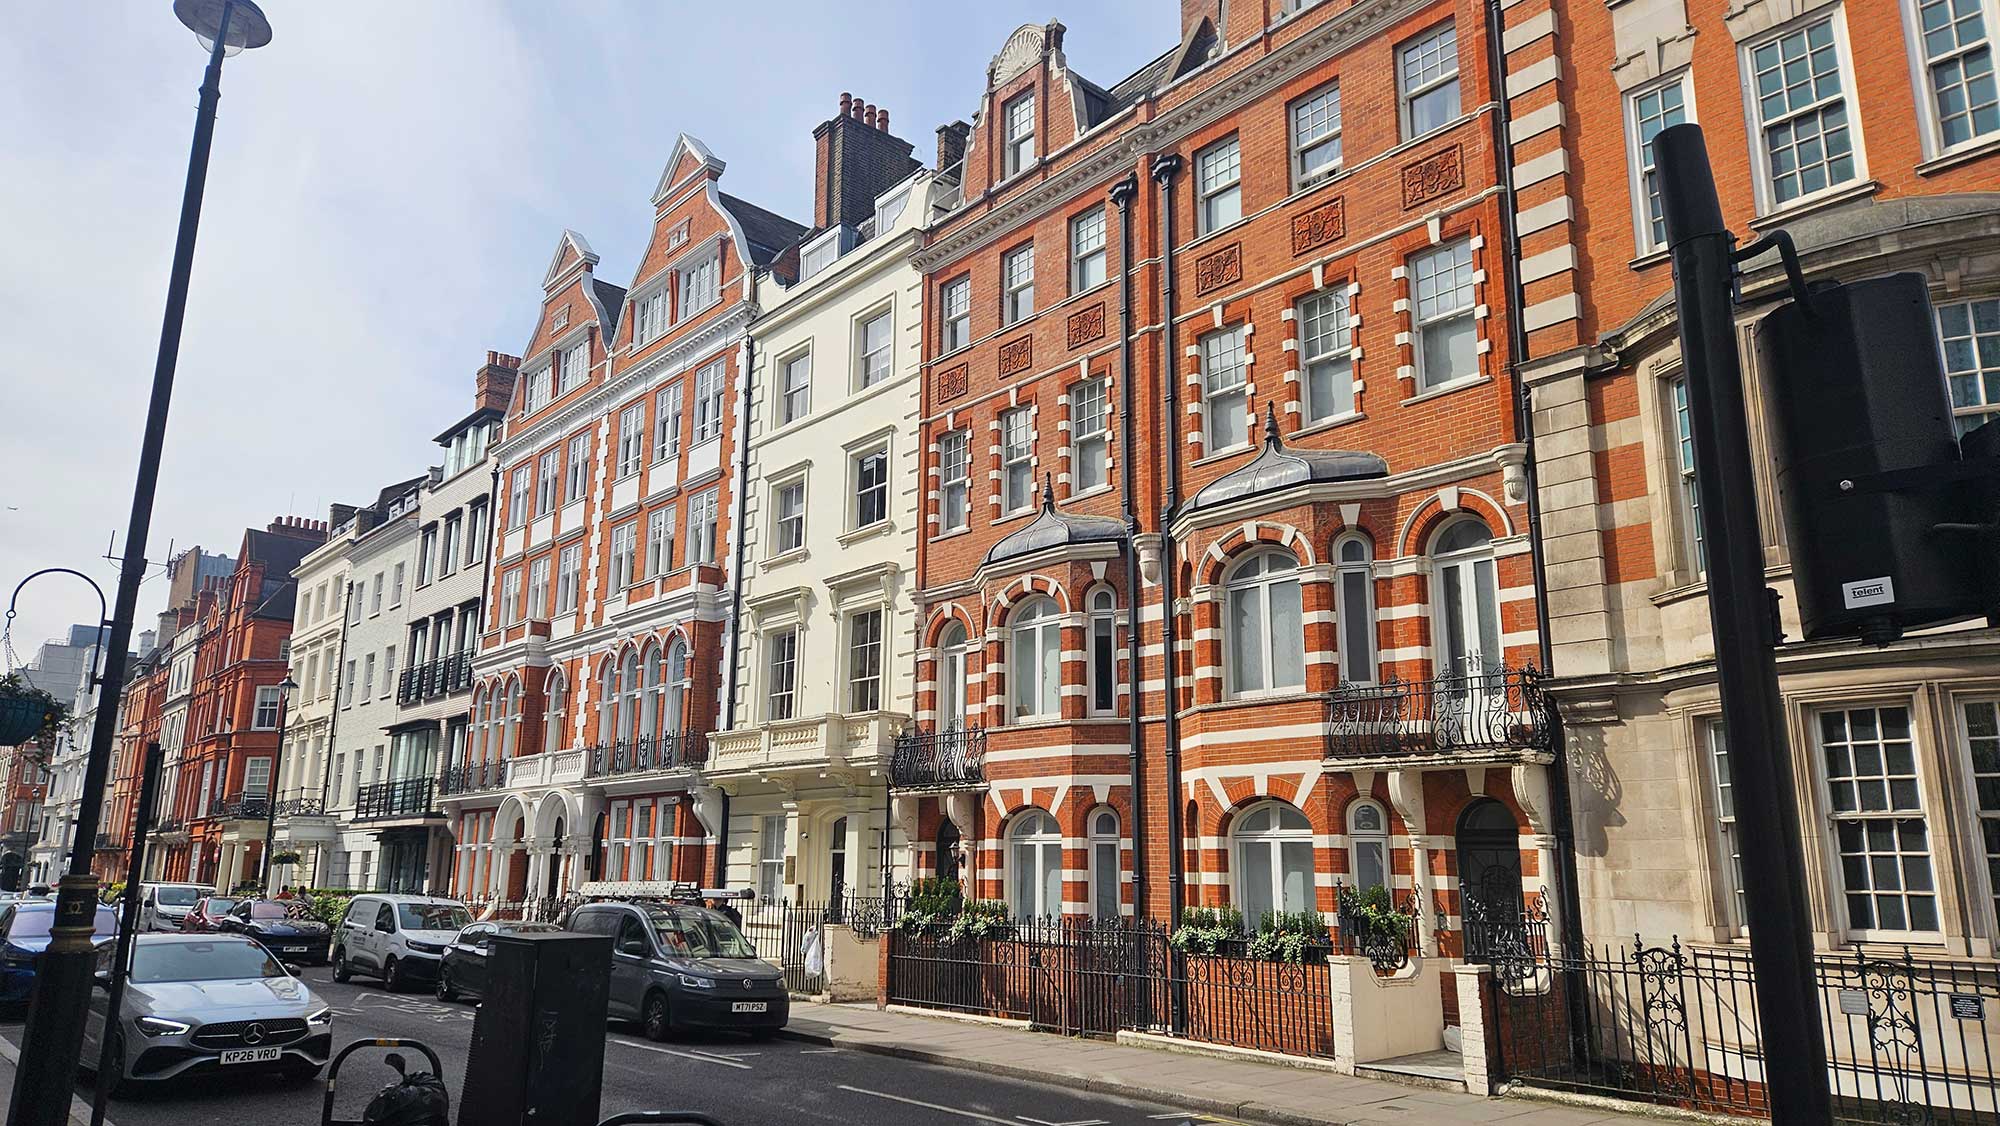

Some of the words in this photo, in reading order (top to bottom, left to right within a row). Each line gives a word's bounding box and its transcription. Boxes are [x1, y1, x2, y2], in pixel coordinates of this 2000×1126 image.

[1852, 585, 1884, 597] telent
[225, 1050, 254, 1062] KP26
[257, 1048, 277, 1060] VRO
